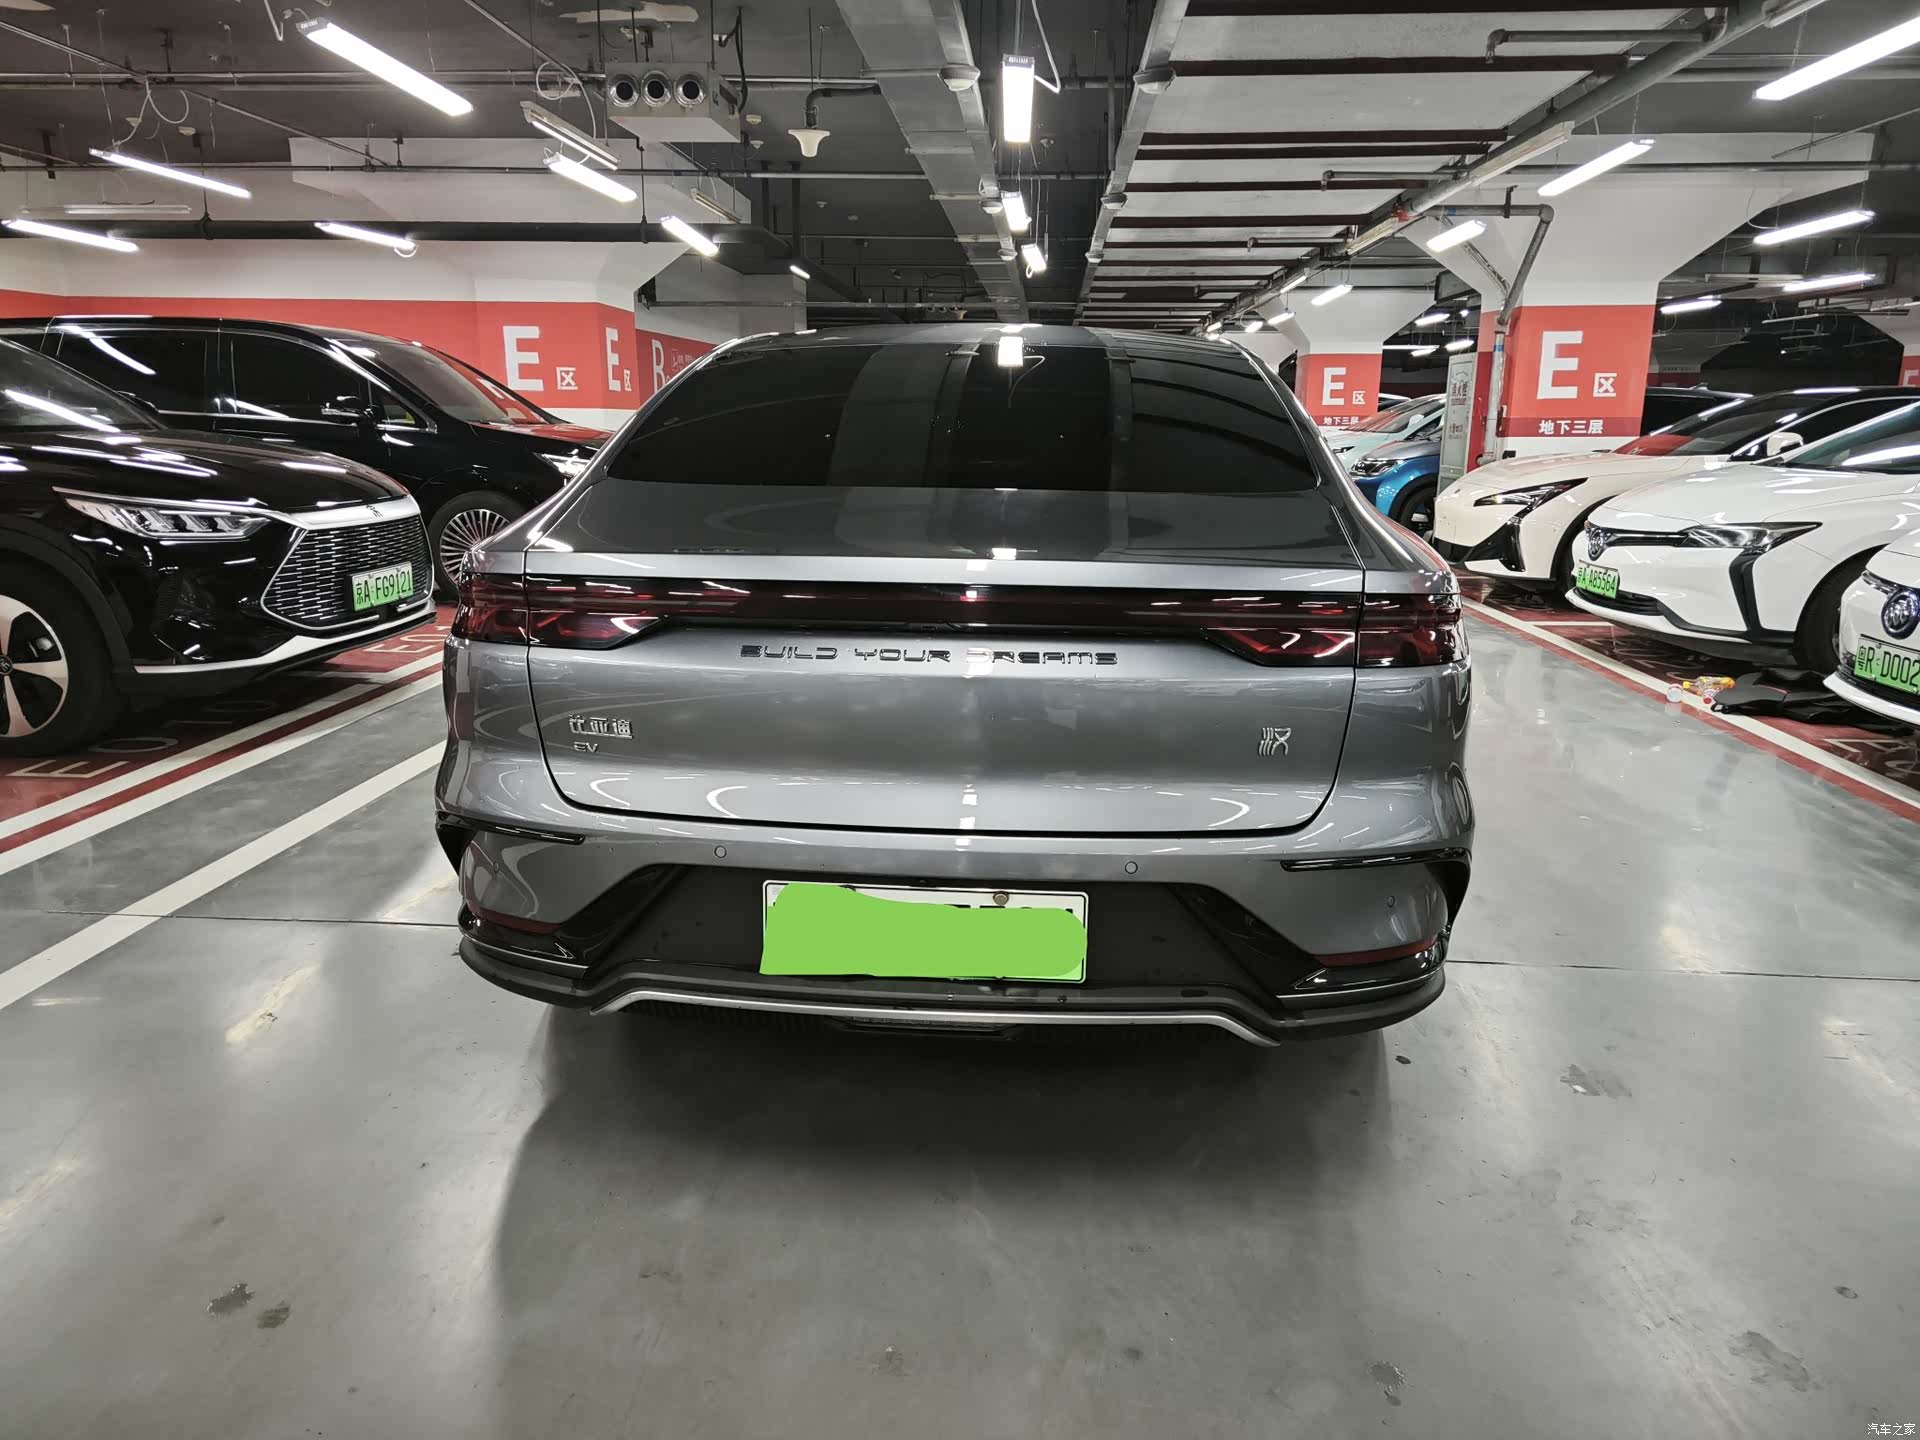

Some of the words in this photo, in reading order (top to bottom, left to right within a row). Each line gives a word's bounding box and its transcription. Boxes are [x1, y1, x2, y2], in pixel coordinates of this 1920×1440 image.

[502, 325, 544, 392] E
[556, 366, 579, 390] 区
[605, 326, 621, 392] E
[1536, 330, 1584, 400] E
[1592, 372, 1617, 398] 区
[1321, 366, 1346, 406] E
[1352, 390, 1366, 405] 区
[1538, 419, 1604, 435] 地下三层
[740, 644, 838, 660] BUILD
[854, 648, 951, 663] YOUR
[965, 647, 1118, 665] DREAMS
[573, 741, 599, 753] EV
